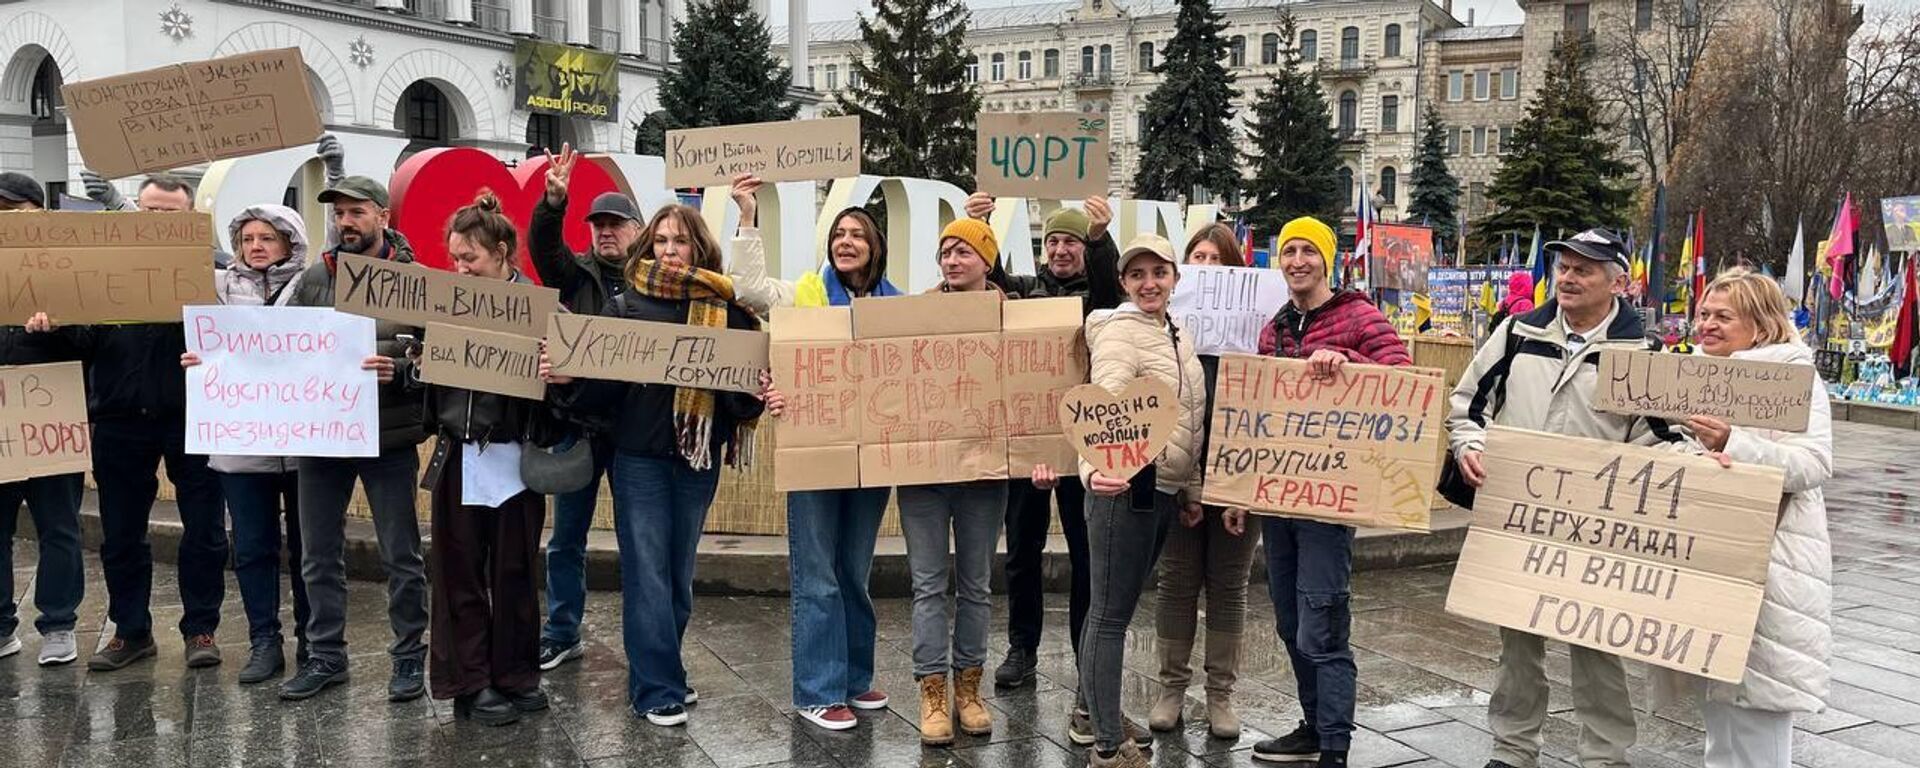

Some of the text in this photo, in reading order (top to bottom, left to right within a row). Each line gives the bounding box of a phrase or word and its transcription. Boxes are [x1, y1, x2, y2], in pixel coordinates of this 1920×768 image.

[233, 79, 249, 95] 5
[572, 101, 608, 116] РОКІВ
[990, 135, 1099, 180] ЧОРТ
[93, 224, 122, 242] НА
[20, 252, 73, 271] АБО
[73, 267, 199, 311] ГЕТЬ
[451, 285, 532, 328] ВІЛЬНА
[1224, 361, 1263, 401] НІ
[1066, 395, 1160, 425] Україна
[1218, 407, 1274, 439] ТАК
[1095, 440, 1151, 470] ТАК
[1594, 454, 1686, 520] 111
[1522, 543, 1680, 601] НА ВАШІ
